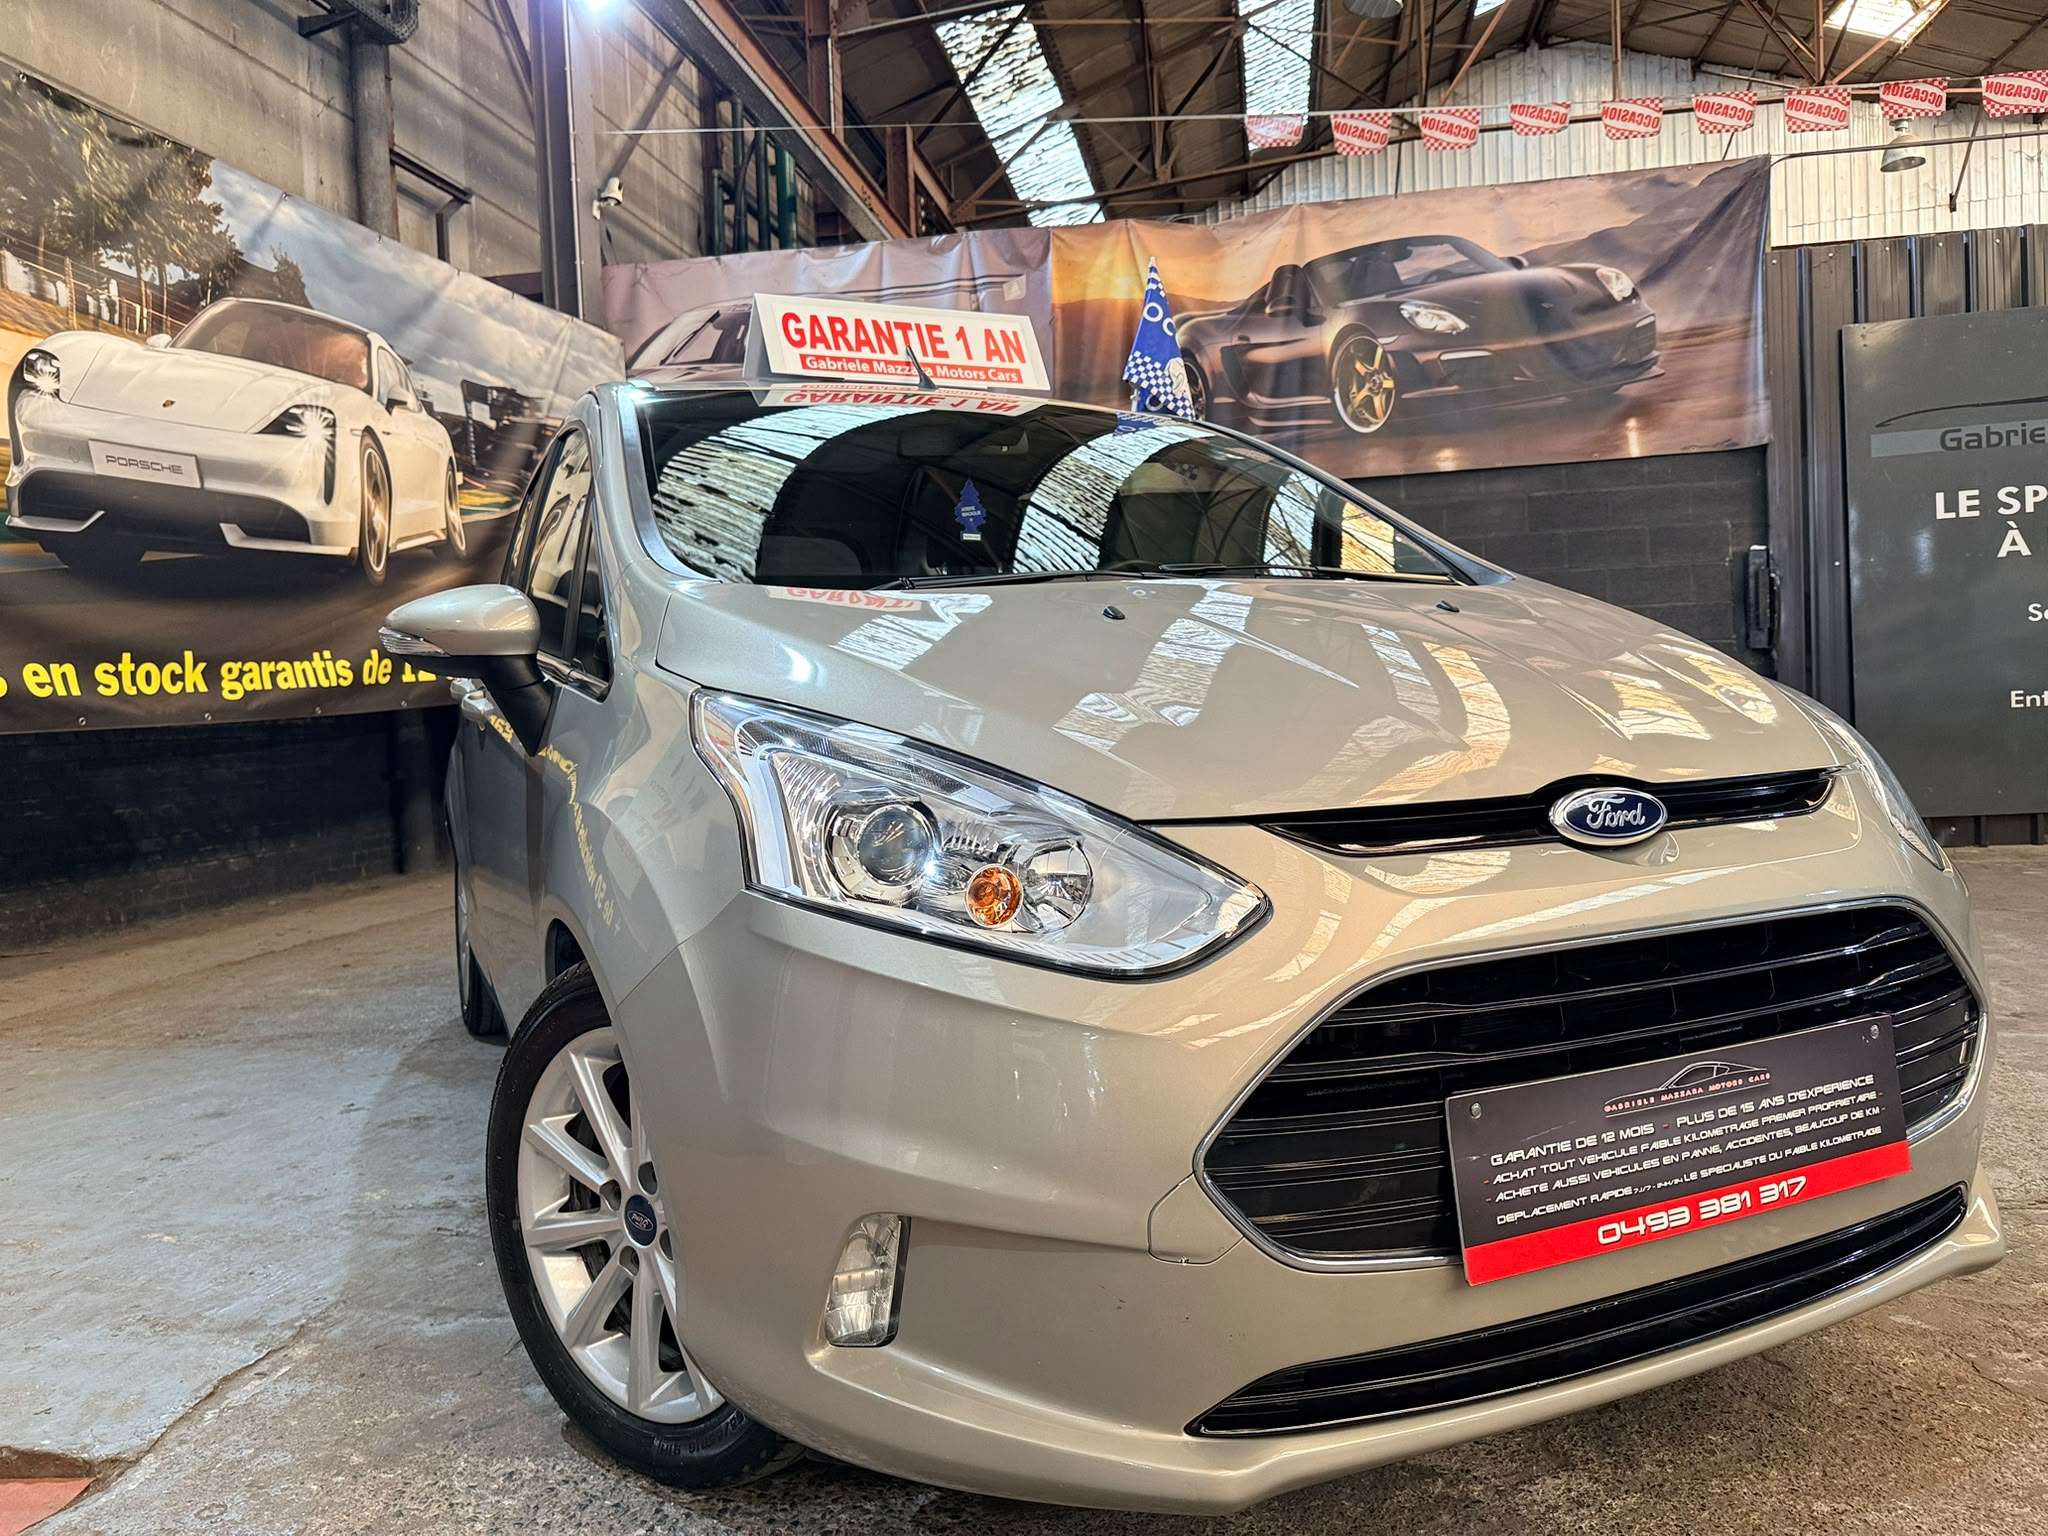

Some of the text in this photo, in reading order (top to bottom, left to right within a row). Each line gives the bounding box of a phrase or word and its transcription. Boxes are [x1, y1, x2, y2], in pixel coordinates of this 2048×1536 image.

[781, 312, 1027, 364] GARANTIE 1 AN
[805, 355, 870, 372] Gabriele
[936, 366, 985, 381] Motors
[988, 368, 1018, 382] Cars
[105, 455, 183, 475] PORSCHE
[1935, 484, 2048, 520] LE SP
[1996, 520, 2032, 558] À
[22, 662, 81, 698] en
[94, 650, 208, 697] stock
[220, 650, 354, 700] garantis
[362, 649, 392, 686] de
[1586, 796, 1646, 830] Ford
[1748, 1072, 1771, 1083] CARS
[1490, 1074, 1875, 1166] GARANTIE DE 12 MOIS PLUS DE 15 ANS D'EXPERIENCE
[1493, 1090, 1877, 1185] ACHAT TOUT VEHICULE FAIBLE KILOMETRAGE PREMIER PROPRIETAIRE
[1495, 1106, 1880, 1202] ACHETE AUSSI VEHICULES EN PANNE, ACCIDENTES, BEAUCOUP DE KM
[1496, 1196, 1587, 1225] DEPLACEMENT
[1590, 1186, 1633, 1204] RAPIDE
[1683, 1171, 1698, 1182] LE
[1700, 1155, 1767, 1178] SPECIALISTE
[1769, 1150, 1783, 1161] DU
[1784, 1142, 1818, 1157] FAIBLE
[1819, 1125, 1882, 1148] KILOMETRAGE
[1597, 1175, 1807, 1245] 0493 381 317
